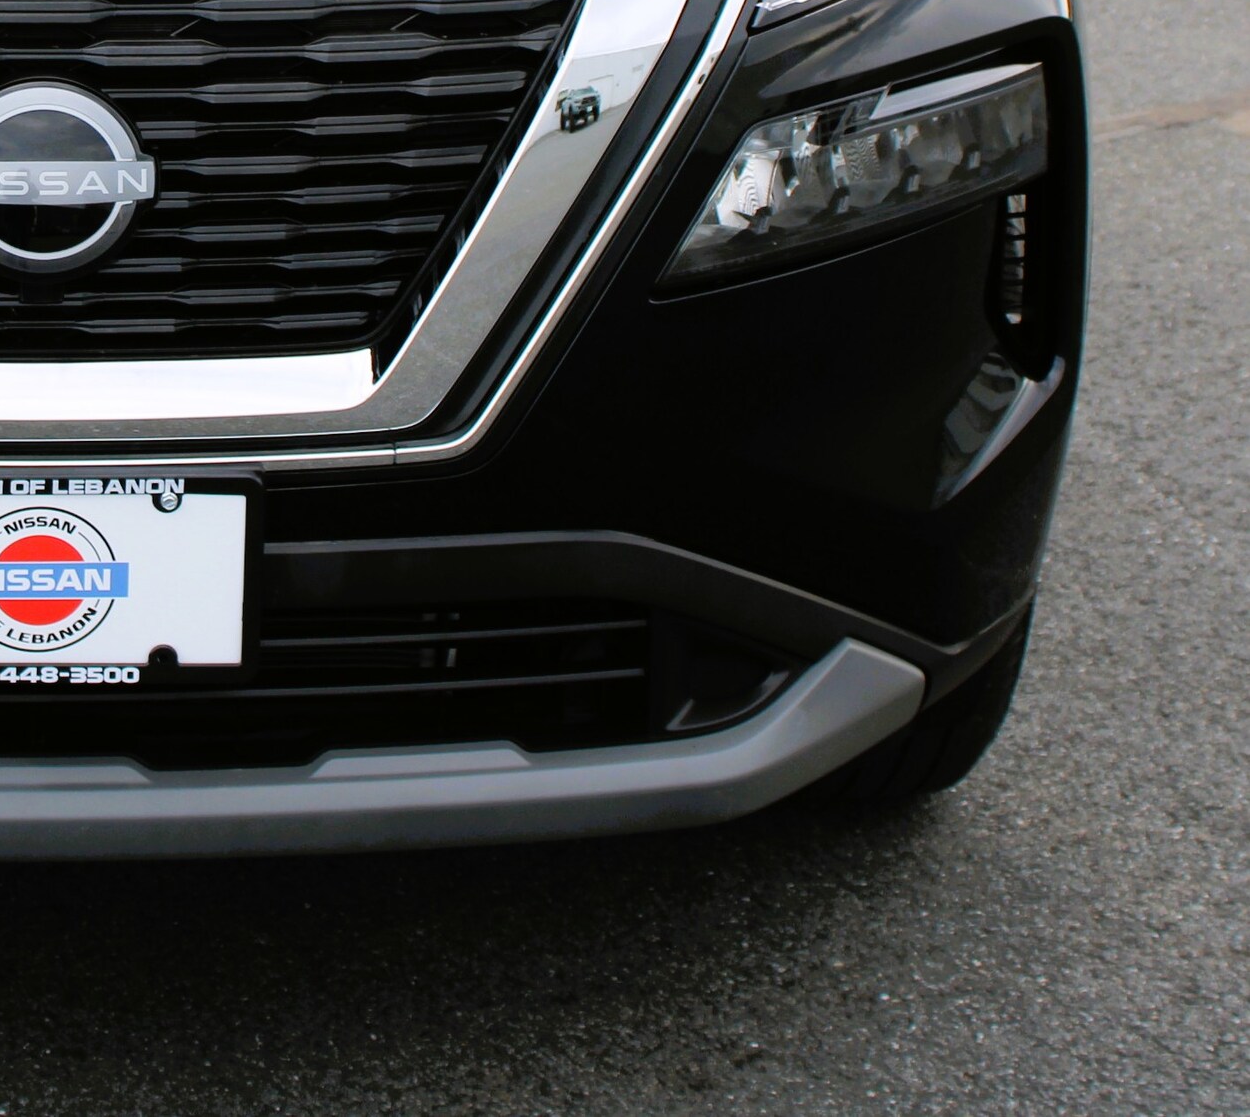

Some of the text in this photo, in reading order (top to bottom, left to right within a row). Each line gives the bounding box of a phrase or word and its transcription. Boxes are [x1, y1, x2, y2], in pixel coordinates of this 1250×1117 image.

[10, 479, 46, 496] OF
[52, 478, 185, 495] LEBANON
[3, 515, 77, 535] NISSAN
[5, 606, 98, 644] LEBANON
